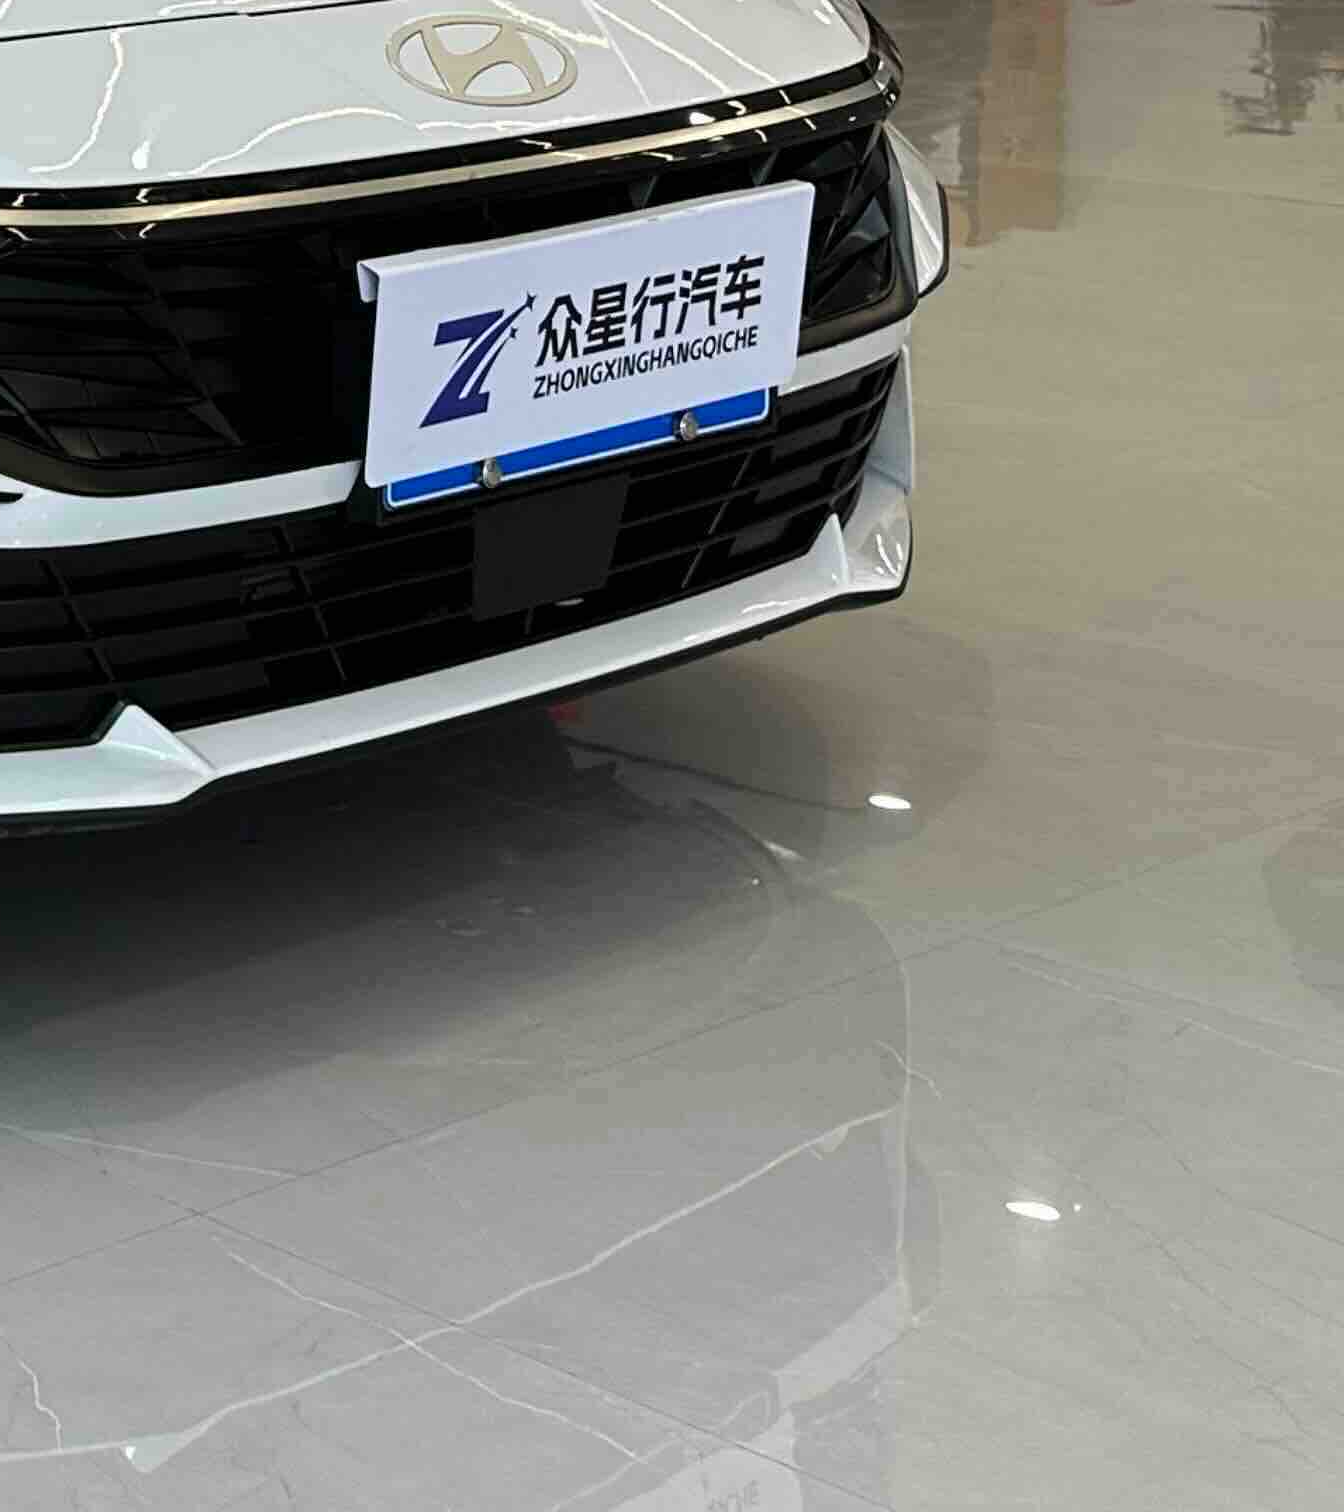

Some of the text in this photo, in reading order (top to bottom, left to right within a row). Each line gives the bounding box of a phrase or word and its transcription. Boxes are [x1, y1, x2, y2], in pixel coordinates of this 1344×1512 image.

[534, 254, 766, 368] 众星行汽车
[532, 324, 760, 400] ZHONGXINGHANGQICHE
